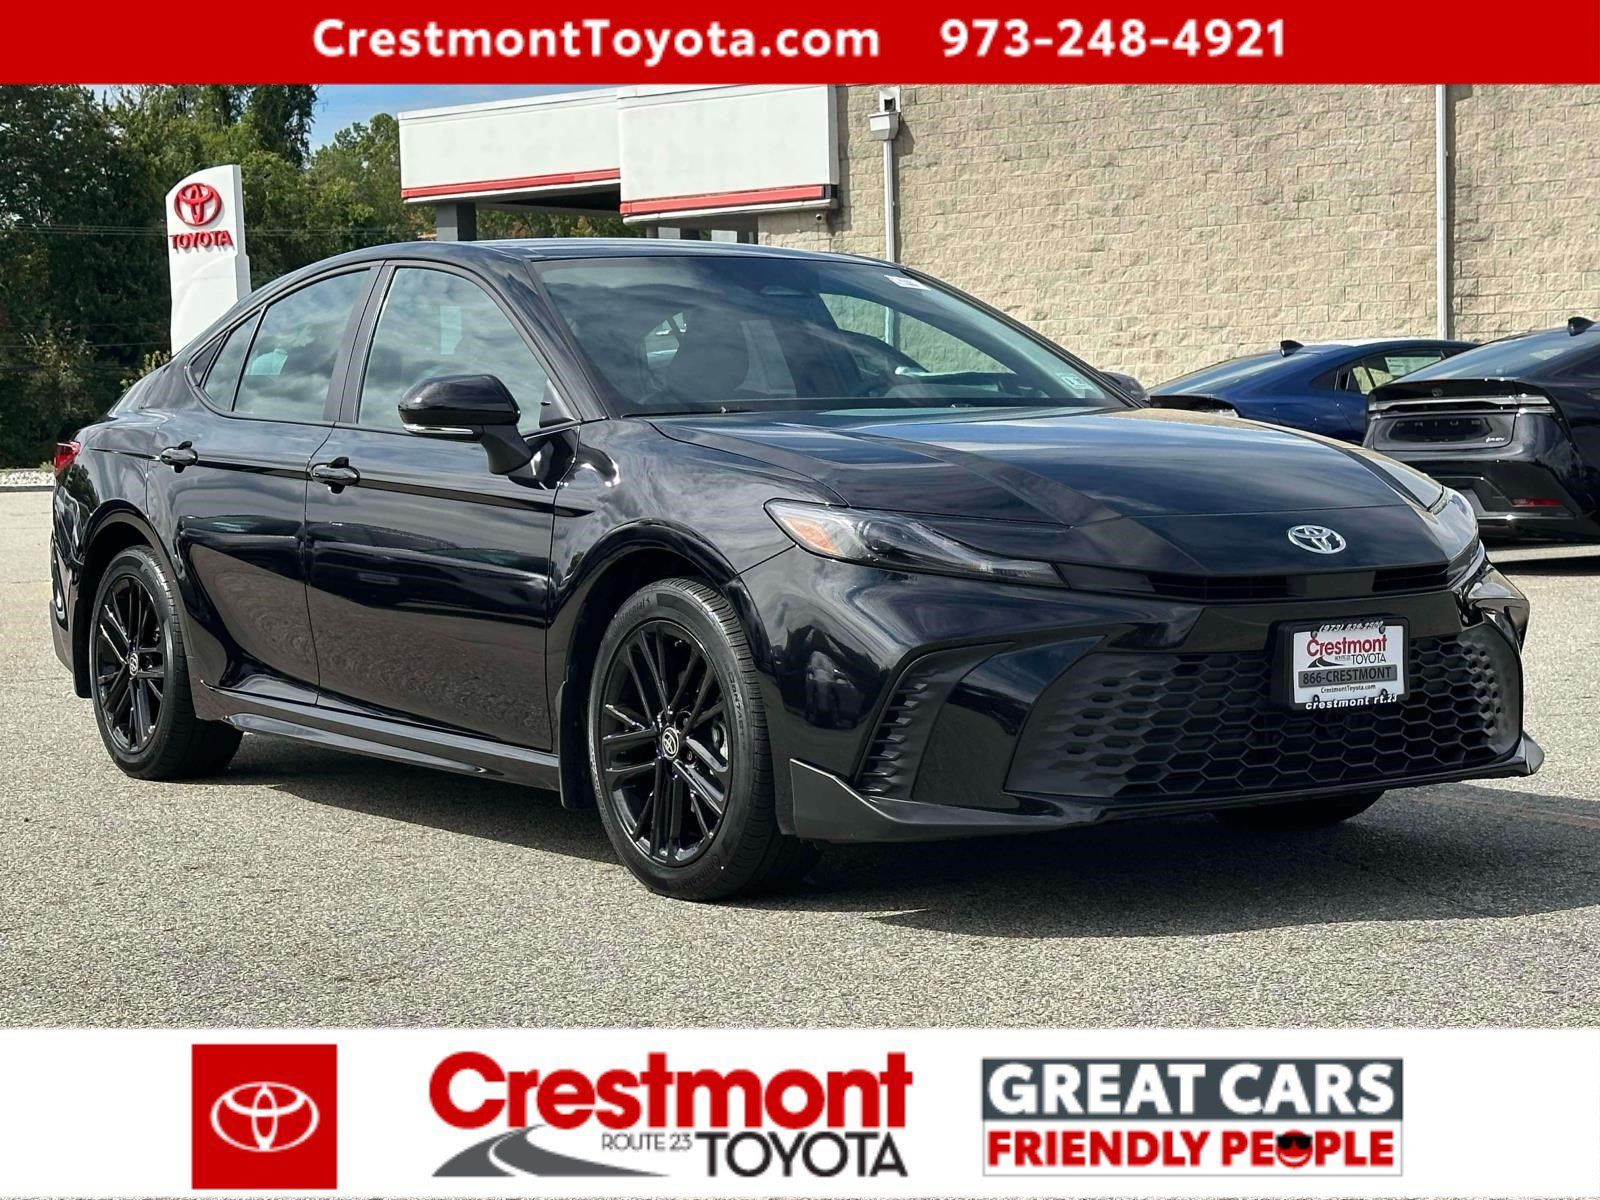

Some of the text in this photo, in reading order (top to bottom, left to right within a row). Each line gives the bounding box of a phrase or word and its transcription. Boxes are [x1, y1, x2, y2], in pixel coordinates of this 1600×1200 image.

[169, 230, 233, 250] TOYOTA
[1306, 634, 1387, 656] Crestmont
[1351, 652, 1387, 665] TOYOTA
[1303, 667, 1391, 684] 866-CRESTMONT
[1320, 685, 1376, 694] CrestmontToyota.com
[1305, 698, 1369, 710] crestmont
